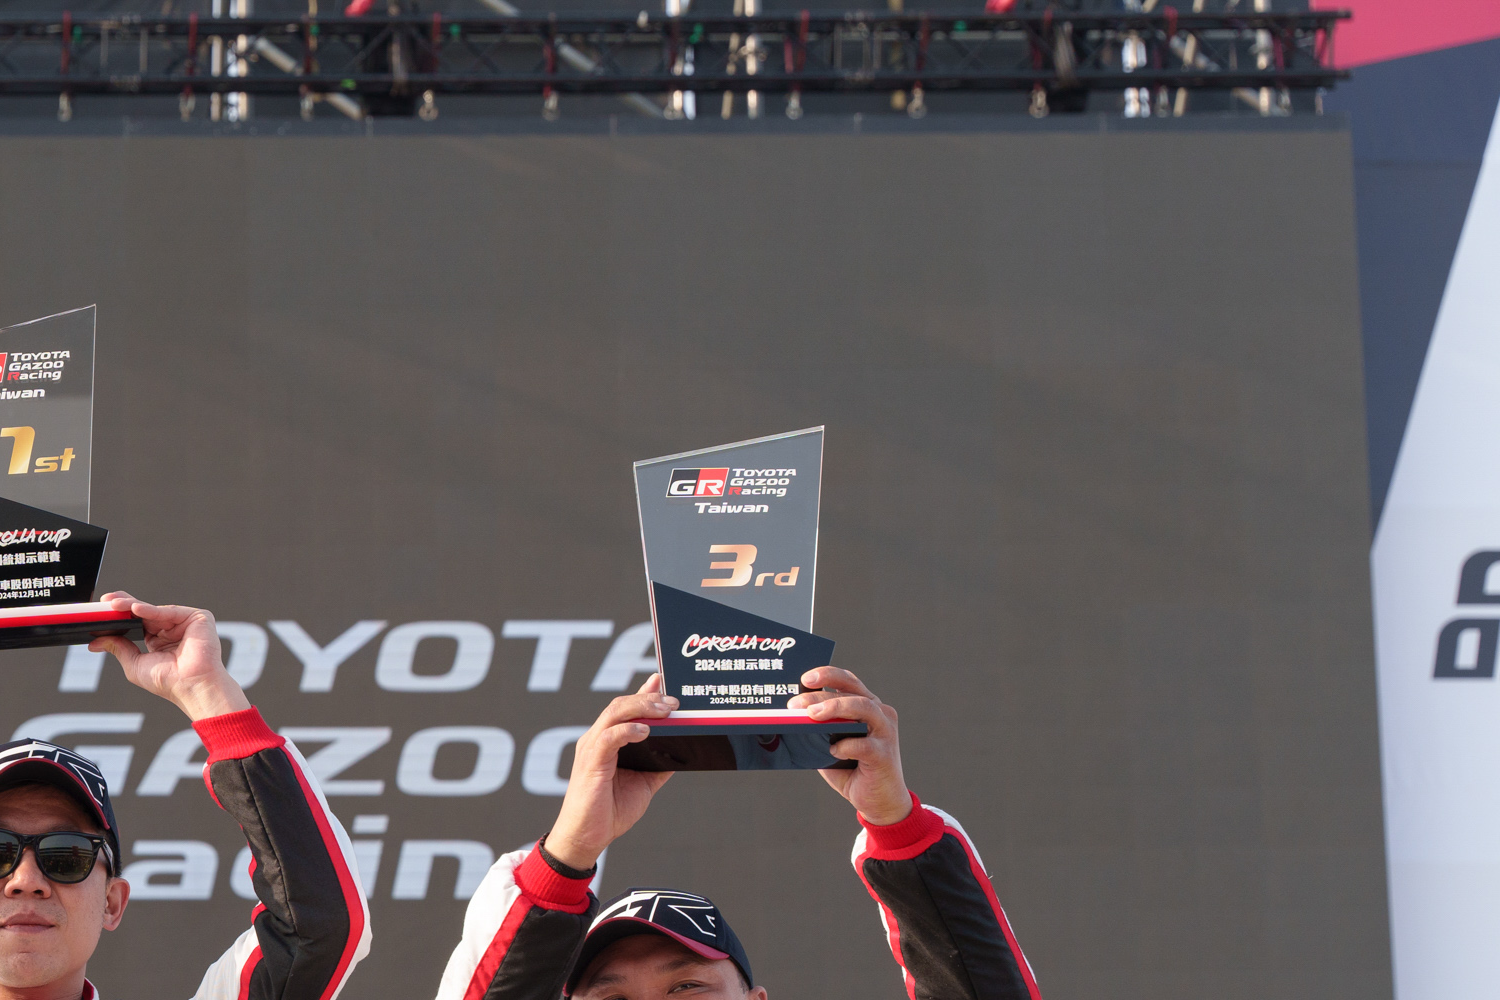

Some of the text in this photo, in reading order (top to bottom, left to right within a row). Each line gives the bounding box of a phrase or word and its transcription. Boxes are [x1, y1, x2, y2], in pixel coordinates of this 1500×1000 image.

[10, 350, 70, 361] TOYOTA
[8, 361, 64, 371] GAZOO
[7, 370, 62, 381] Racing
[0, 426, 76, 475] 1st
[732, 468, 797, 477] TOYOTA
[670, 479, 724, 495] GR
[729, 477, 790, 486] GAZOO
[728, 486, 787, 498] Racing
[695, 502, 769, 514] Taiwan
[700, 544, 800, 587] 3rd
[681, 633, 758, 657] COROLLA
[681, 684, 799, 697] 和泰汽車股份有限公司
[710, 696, 772, 705] 2024年12月14日
